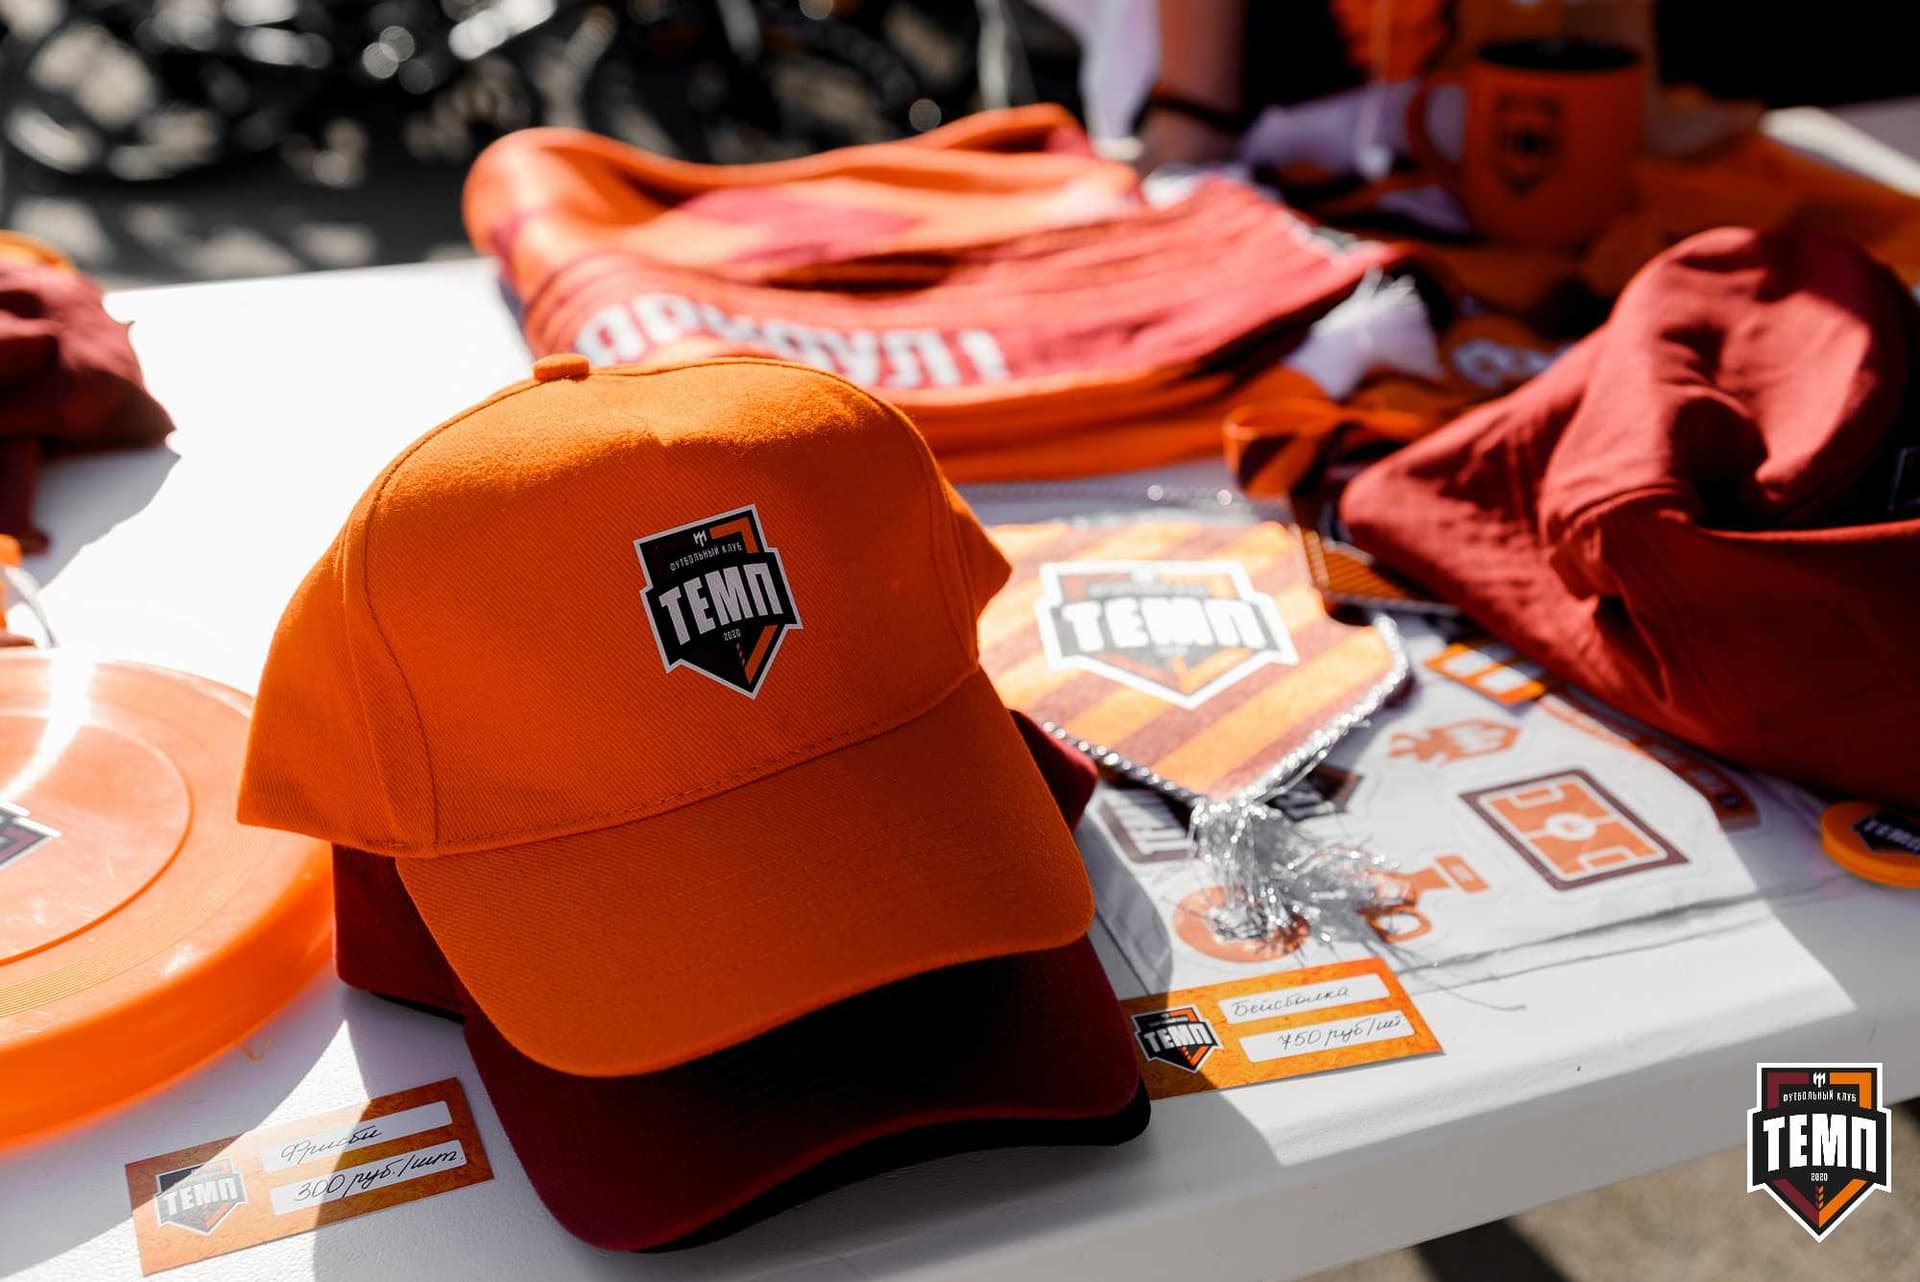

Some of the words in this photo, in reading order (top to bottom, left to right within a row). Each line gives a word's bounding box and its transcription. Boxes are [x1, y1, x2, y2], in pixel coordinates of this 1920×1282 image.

[669, 546, 720, 572] ФУТБОЛЬНЫЙ
[722, 541, 743, 554] КЛУБ
[658, 562, 784, 646] ТЕМП
[723, 628, 742, 642] 2020
[1060, 595, 1267, 653] ТЕМП
[1143, 1023, 1213, 1053] ТЕМП
[1278, 1029, 1322, 1051] 750
[280, 1125, 383, 1165] Фрисби
[162, 1177, 238, 1216] ТЕМП
[294, 1173, 346, 1202] 300
